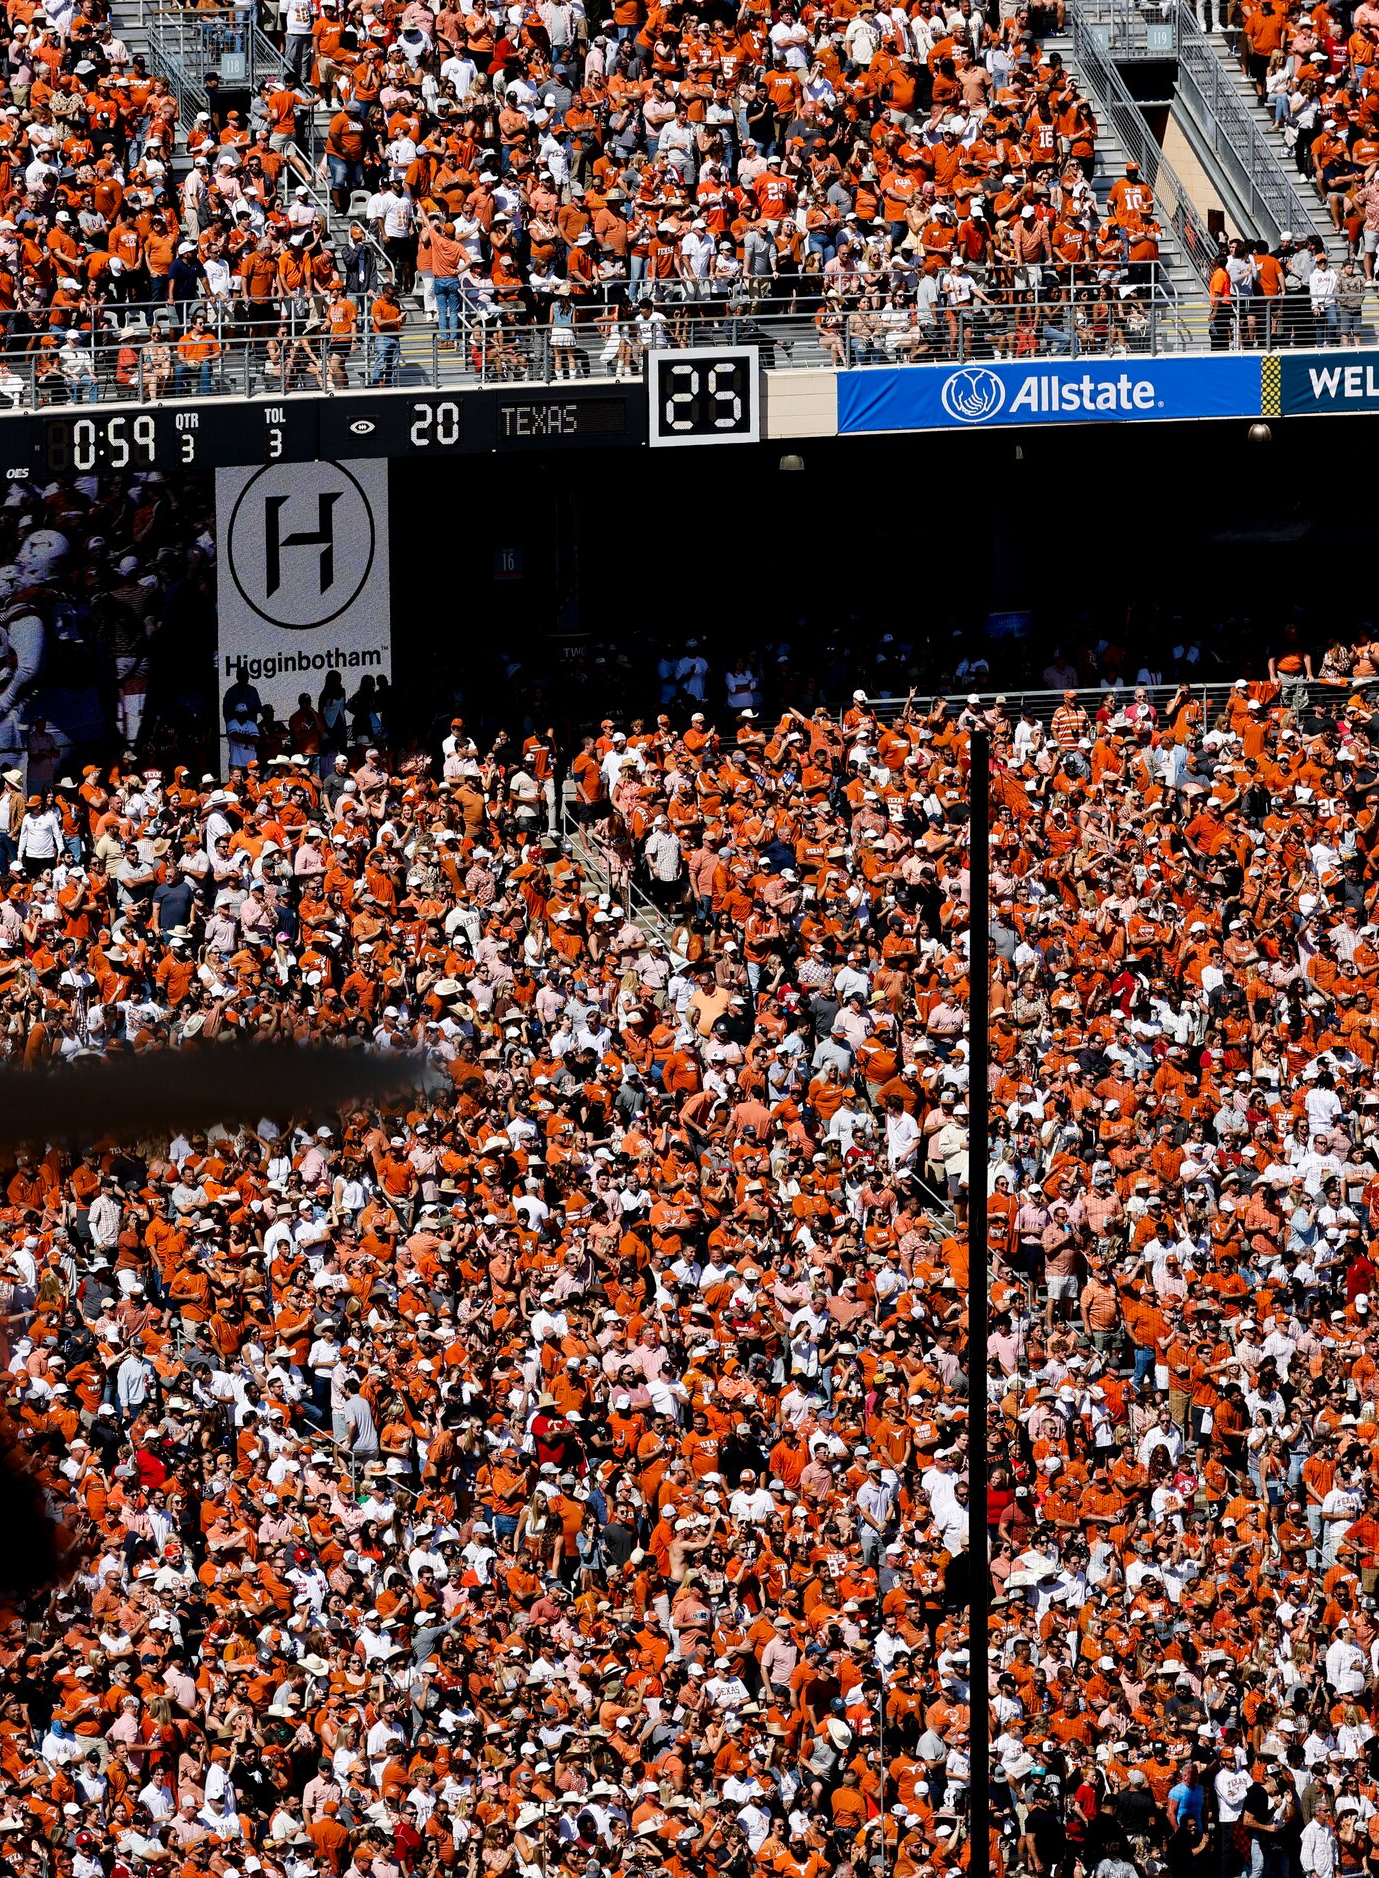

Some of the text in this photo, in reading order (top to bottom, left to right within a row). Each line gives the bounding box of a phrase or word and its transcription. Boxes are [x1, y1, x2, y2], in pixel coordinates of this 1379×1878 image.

[326, 26, 340, 34] Texas
[1154, 32, 1166, 44] 119
[227, 61, 239, 73] 118
[723, 62, 734, 78] 5
[1040, 132, 1054, 147] 16
[1125, 194, 1142, 210] 10
[1063, 232, 1082, 243] Texas
[666, 363, 742, 430] 25
[1009, 374, 1156, 413] Allstate
[175, 413, 199, 430] QTR
[264, 407, 286, 424] TOL
[410, 402, 459, 446] 20
[501, 405, 578, 436] TEXAS
[73, 415, 155, 471] 0:59
[180, 433, 195, 463] 3
[269, 429, 283, 458] 3
[265, 491, 345, 600] H
[502, 551, 515, 570] 16
[225, 647, 381, 680] Higginbotham
[144, 771, 162, 779] TEXAS
[1337, 1497, 1358, 1505] TEXAS
[780, 1570, 786, 1584] 1
[1228, 1777, 1248, 1787] TEXAS
